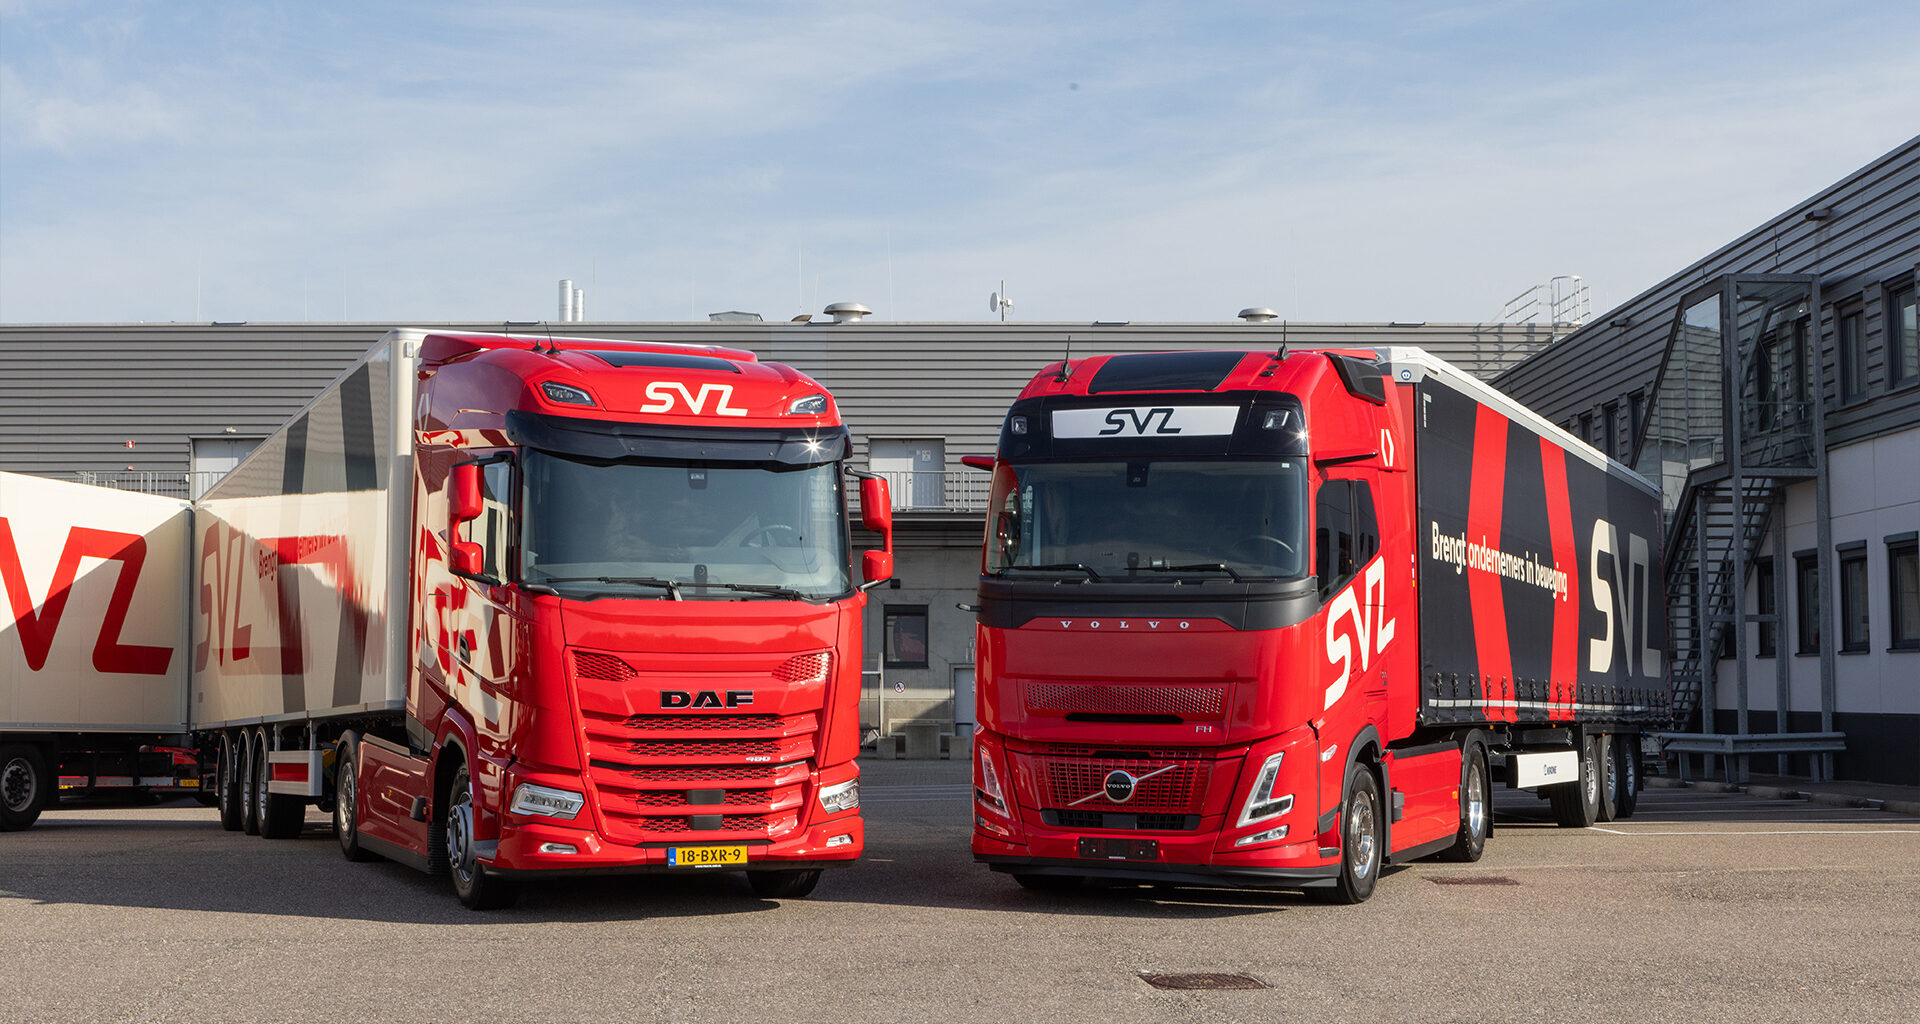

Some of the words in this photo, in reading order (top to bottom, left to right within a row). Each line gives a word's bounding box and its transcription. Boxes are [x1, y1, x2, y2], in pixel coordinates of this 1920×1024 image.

[640, 381, 748, 417] SVZ
[1098, 408, 1182, 435] SVZ
[1432, 521, 1467, 574] Brengt
[1468, 535, 1525, 582] ondernemers
[1525, 550, 1535, 585] in
[1535, 553, 1567, 602] beweging
[0, 516, 174, 676] VZ
[1590, 518, 1661, 678] SVZ
[1061, 621, 1190, 629] VOLVO
[1324, 555, 1396, 711] SVZ
[660, 690, 754, 709] DAF
[1195, 725, 1212, 733] FH
[681, 848, 741, 863] 18-BXR-9
